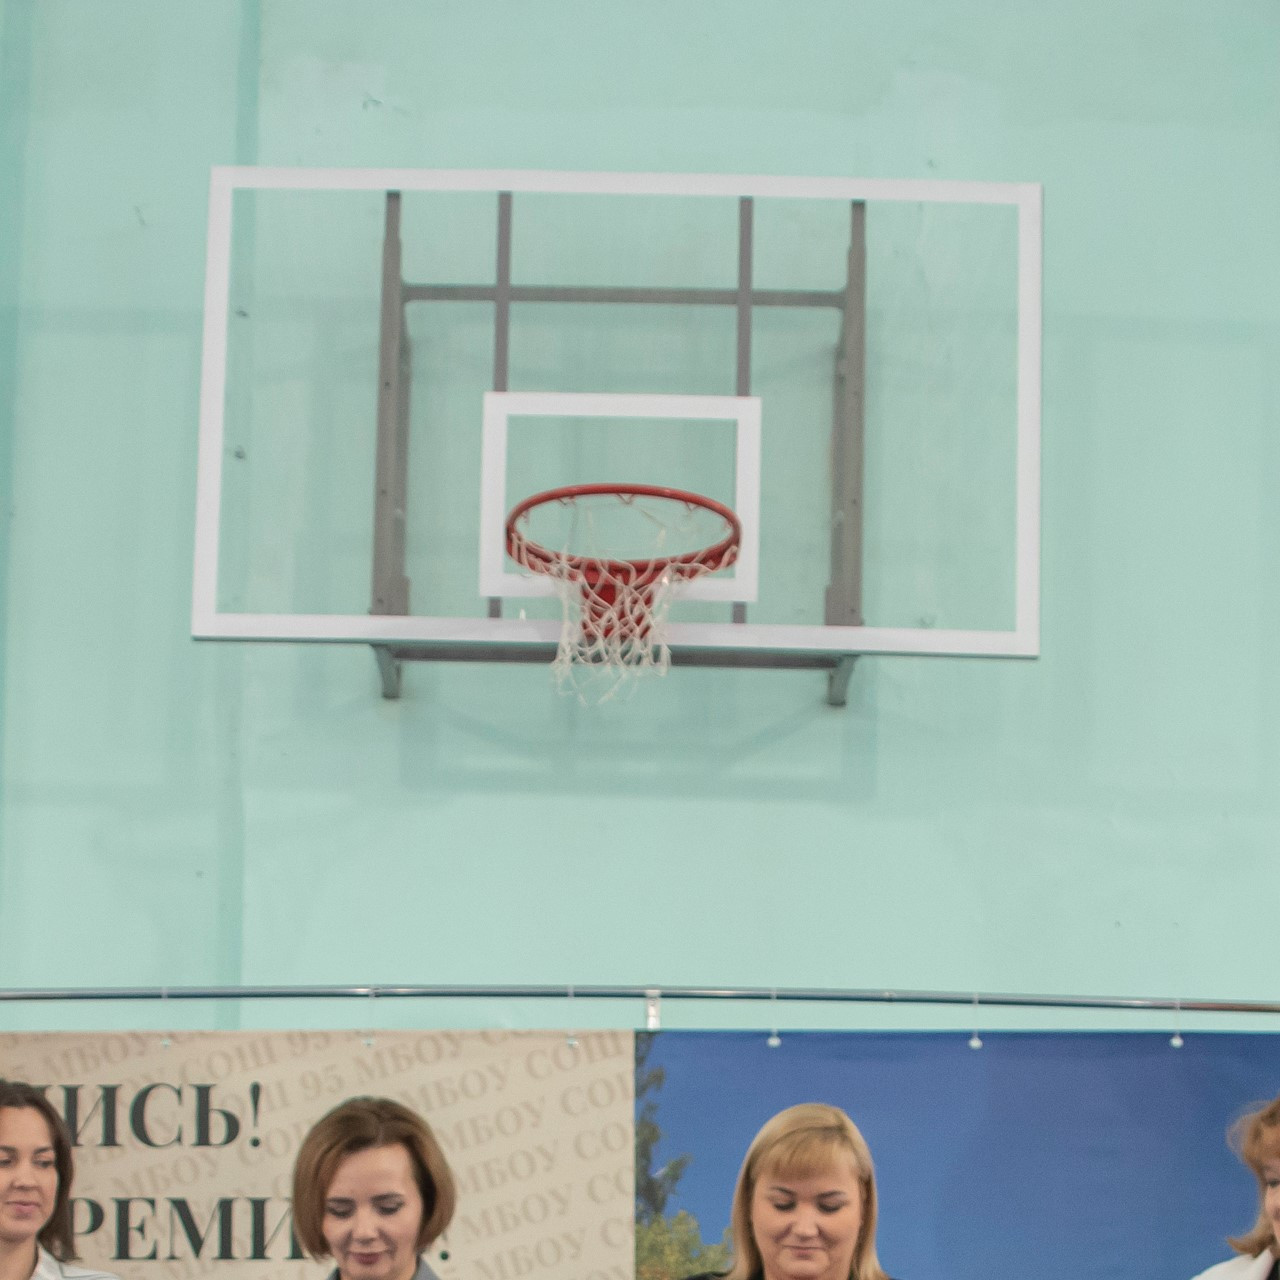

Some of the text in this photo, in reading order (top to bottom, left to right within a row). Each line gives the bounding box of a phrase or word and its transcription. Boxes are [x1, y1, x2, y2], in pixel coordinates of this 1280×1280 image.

[299, 1063, 345, 1102] 95
[353, 1032, 462, 1083] МБОУ
[460, 1183, 573, 1244] МБОУ
